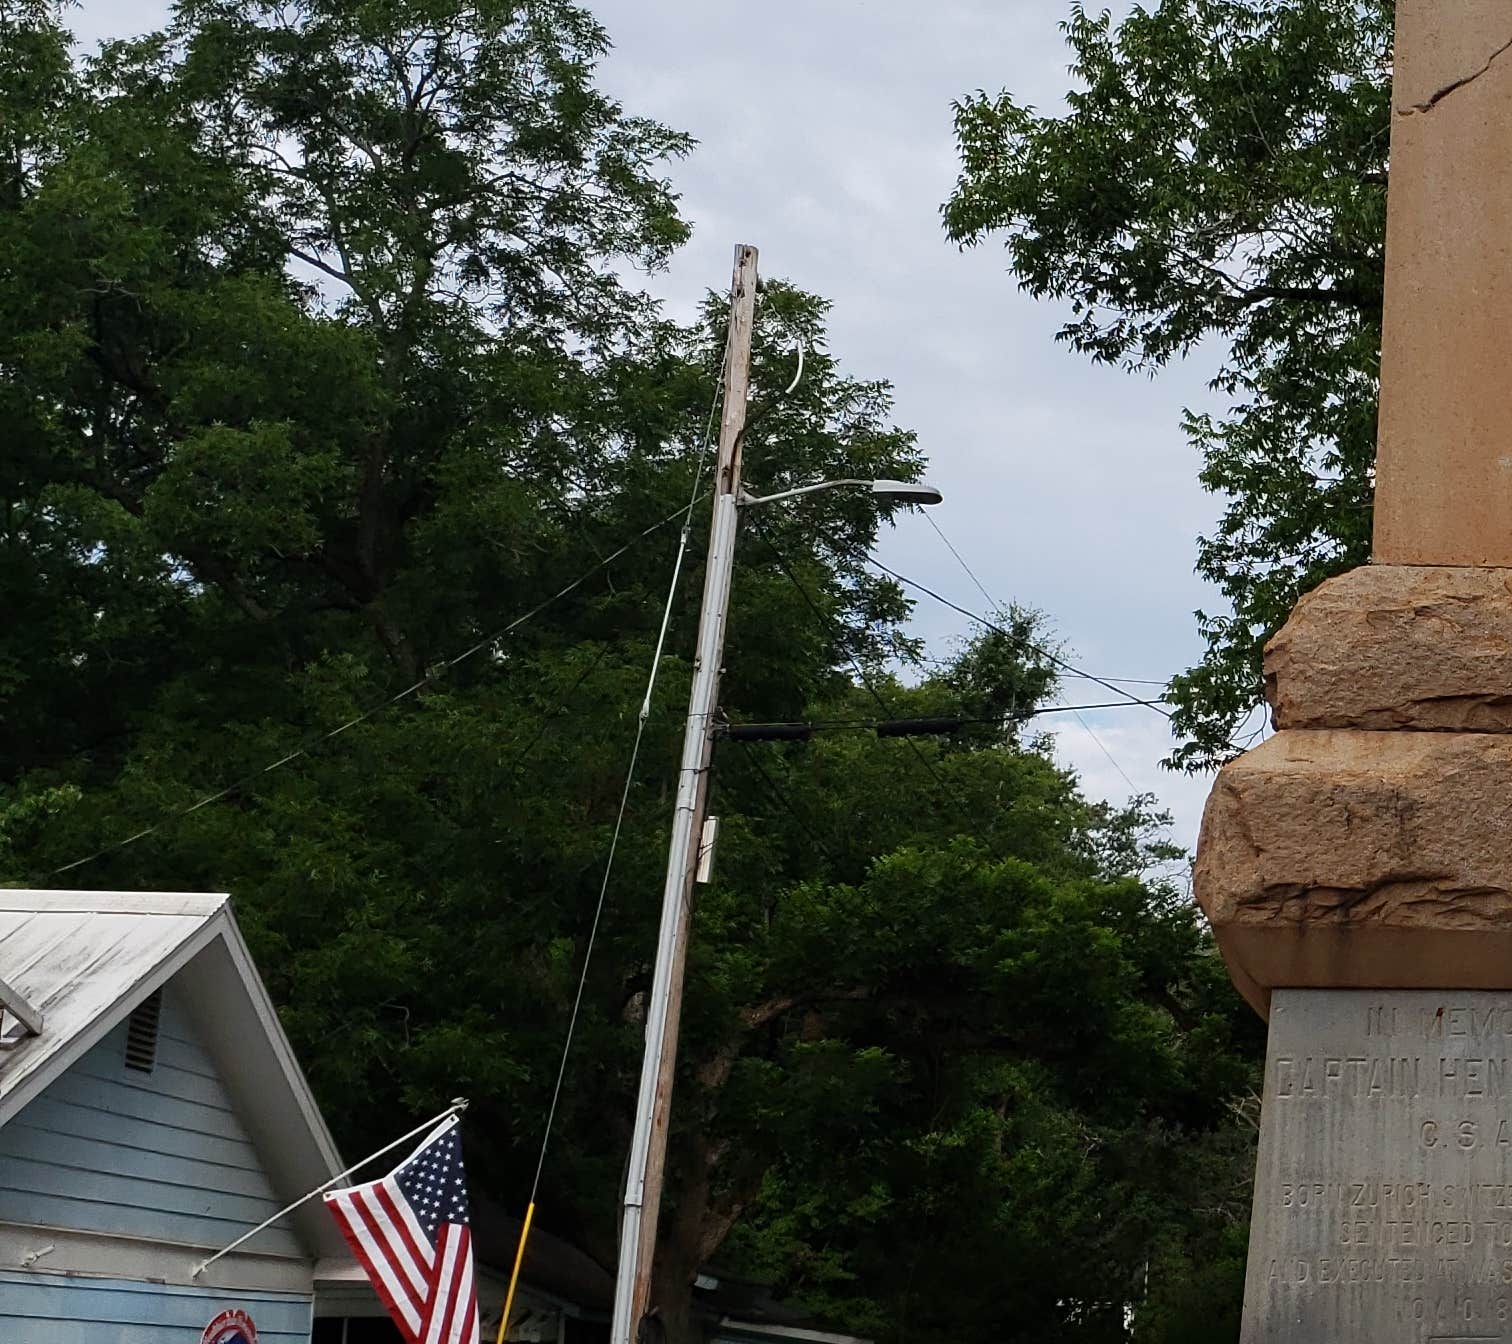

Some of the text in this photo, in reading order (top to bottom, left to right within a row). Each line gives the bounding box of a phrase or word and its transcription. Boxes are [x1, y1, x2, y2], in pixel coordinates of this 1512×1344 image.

[1365, 1007, 1399, 1037] IN
[1275, 1057, 1421, 1099] CAPTAIN
[1281, 1184, 1342, 1207] BORN
[1339, 1221, 1473, 1245] SENTENCED
[1268, 1259, 1310, 1284] AND
[1319, 1258, 1425, 1284] EXECUTED
[1434, 1258, 1459, 1283] AT
